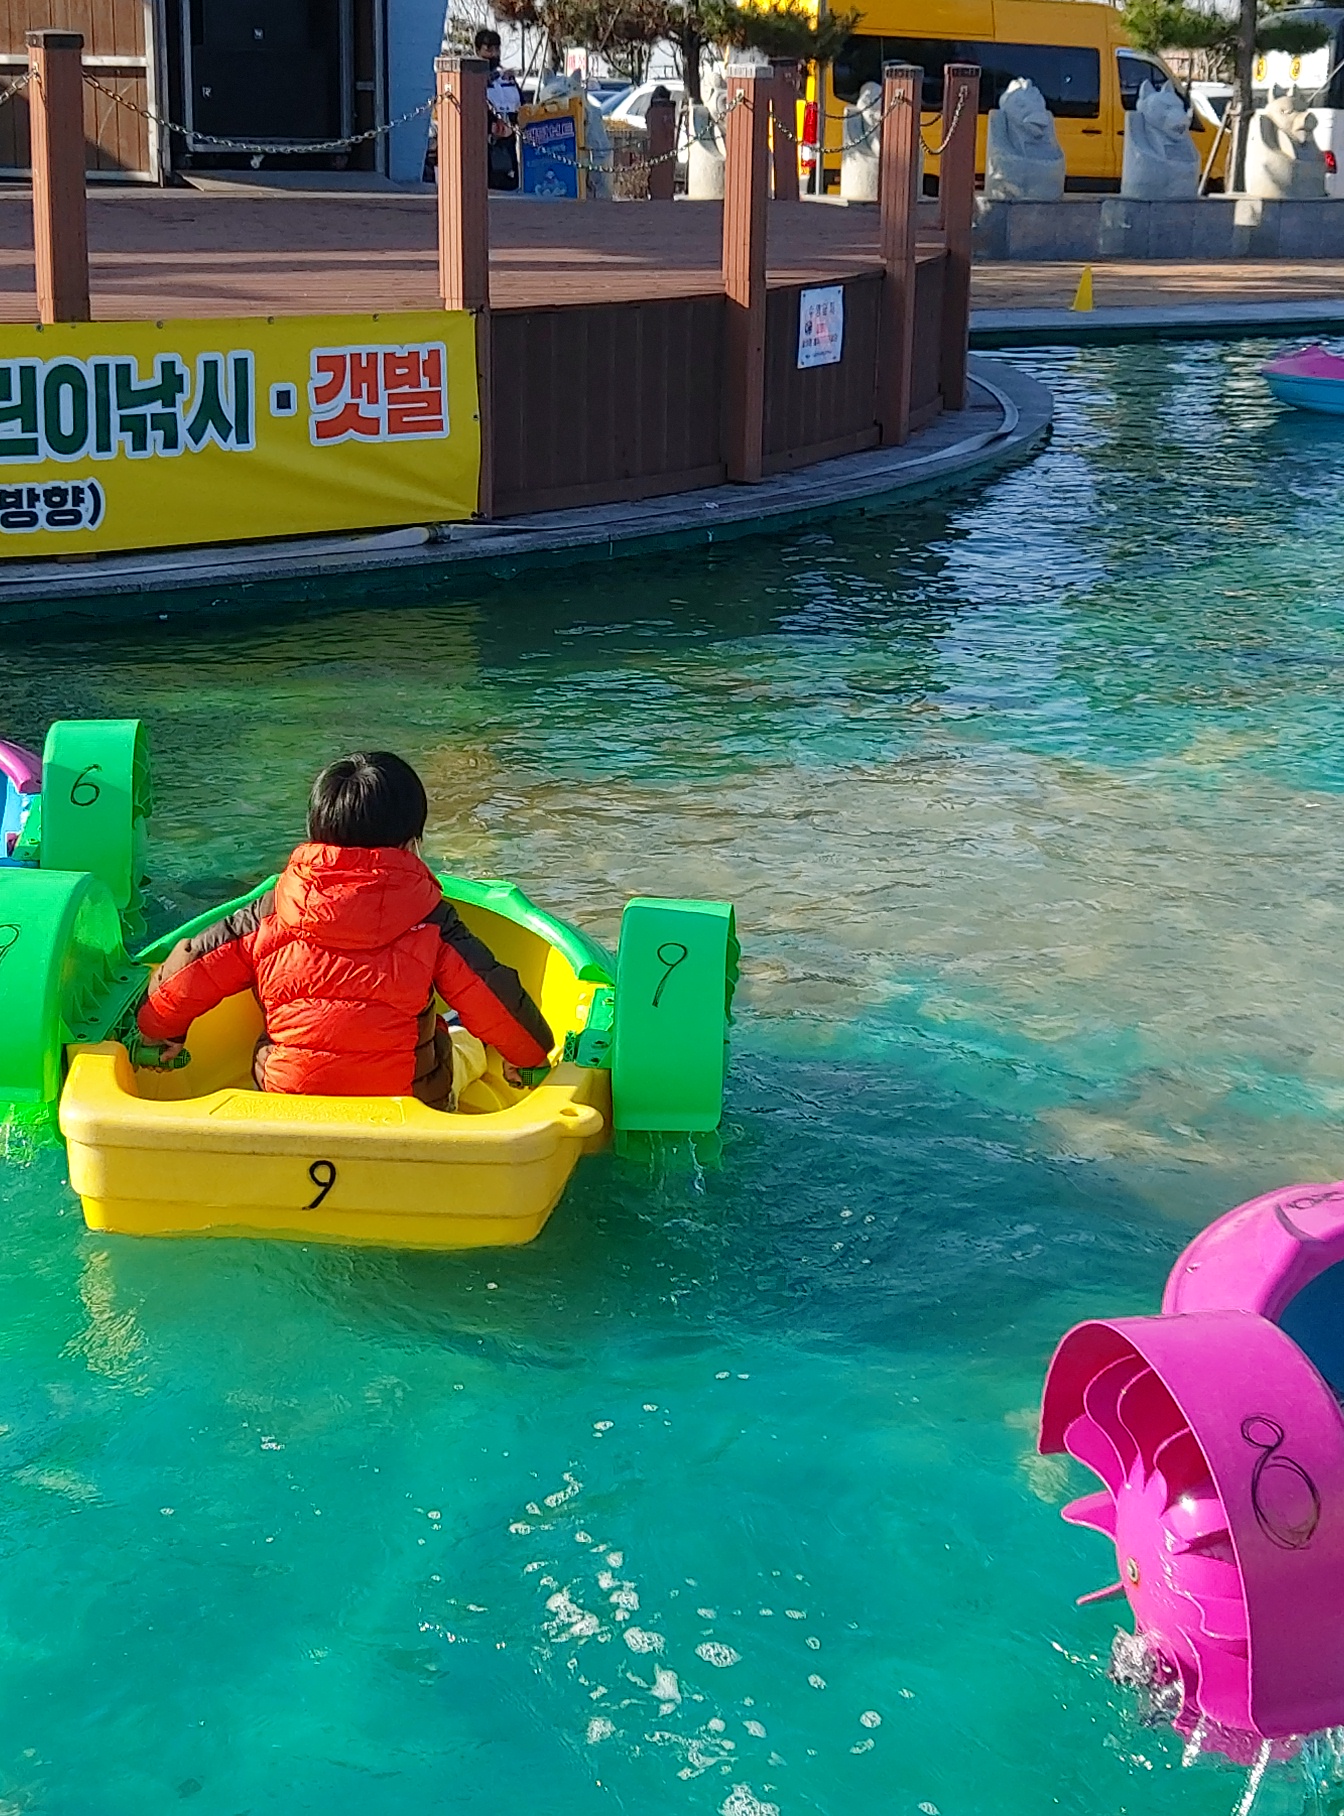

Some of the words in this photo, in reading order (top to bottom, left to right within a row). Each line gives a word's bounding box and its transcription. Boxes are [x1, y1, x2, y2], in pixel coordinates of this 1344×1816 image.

[314, 348, 445, 440] 갯벌
[71, 763, 102, 807] 6
[651, 942, 689, 1008] 9
[301, 1158, 337, 1211] 9
[1240, 1412, 1321, 1551] 8
